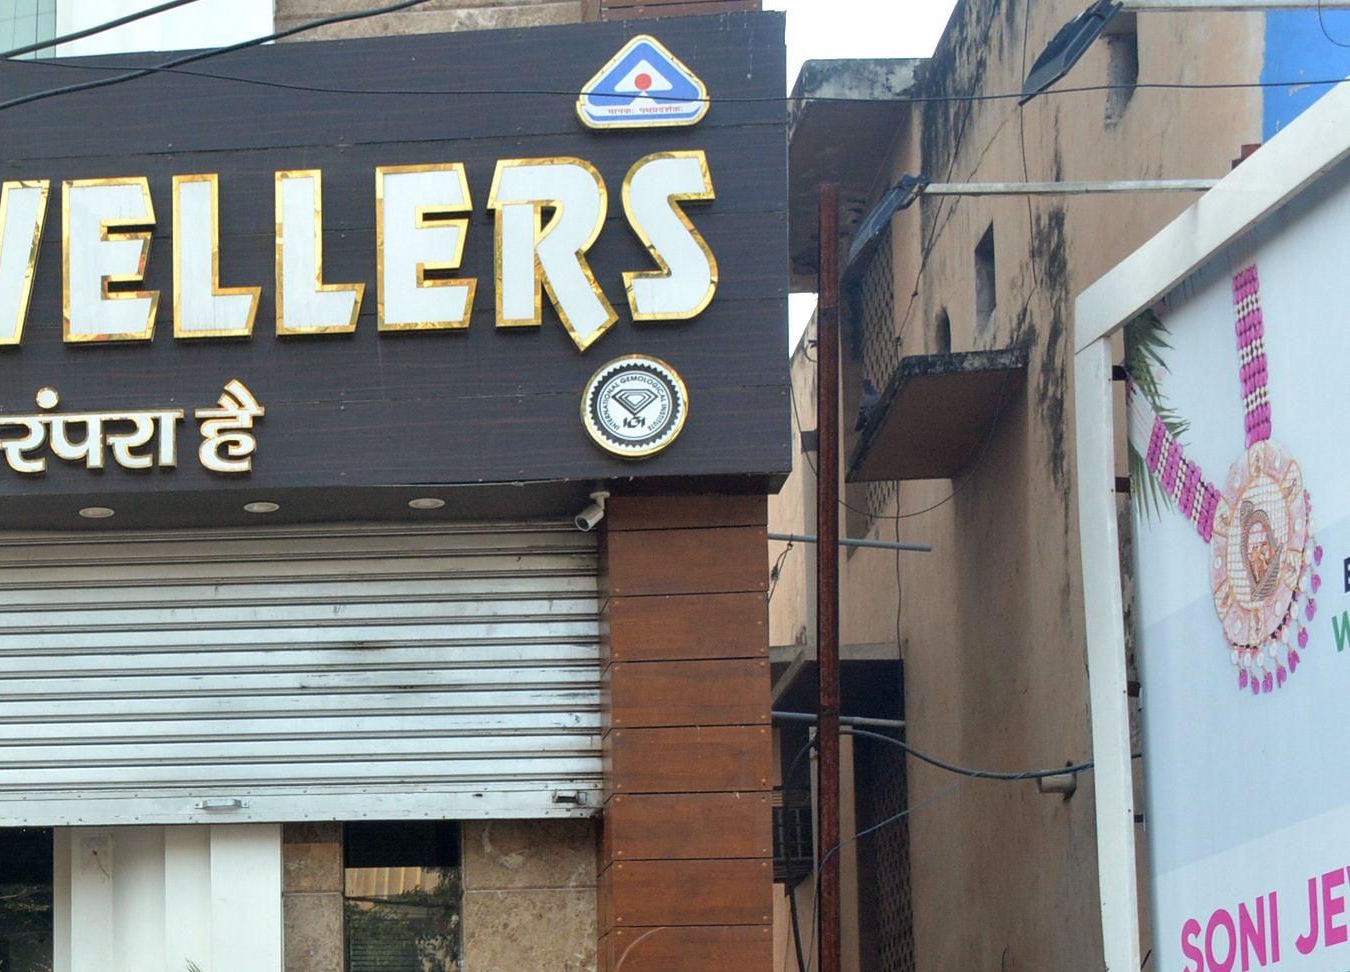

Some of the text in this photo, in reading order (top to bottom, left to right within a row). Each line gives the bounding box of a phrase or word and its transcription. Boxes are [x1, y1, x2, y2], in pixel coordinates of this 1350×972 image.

[195, 379, 265, 474] है
[601, 375, 669, 431] INTERNATIONAL GEMOLOGICAL INSTITUTE
[1295, 865, 1350, 955] JE
